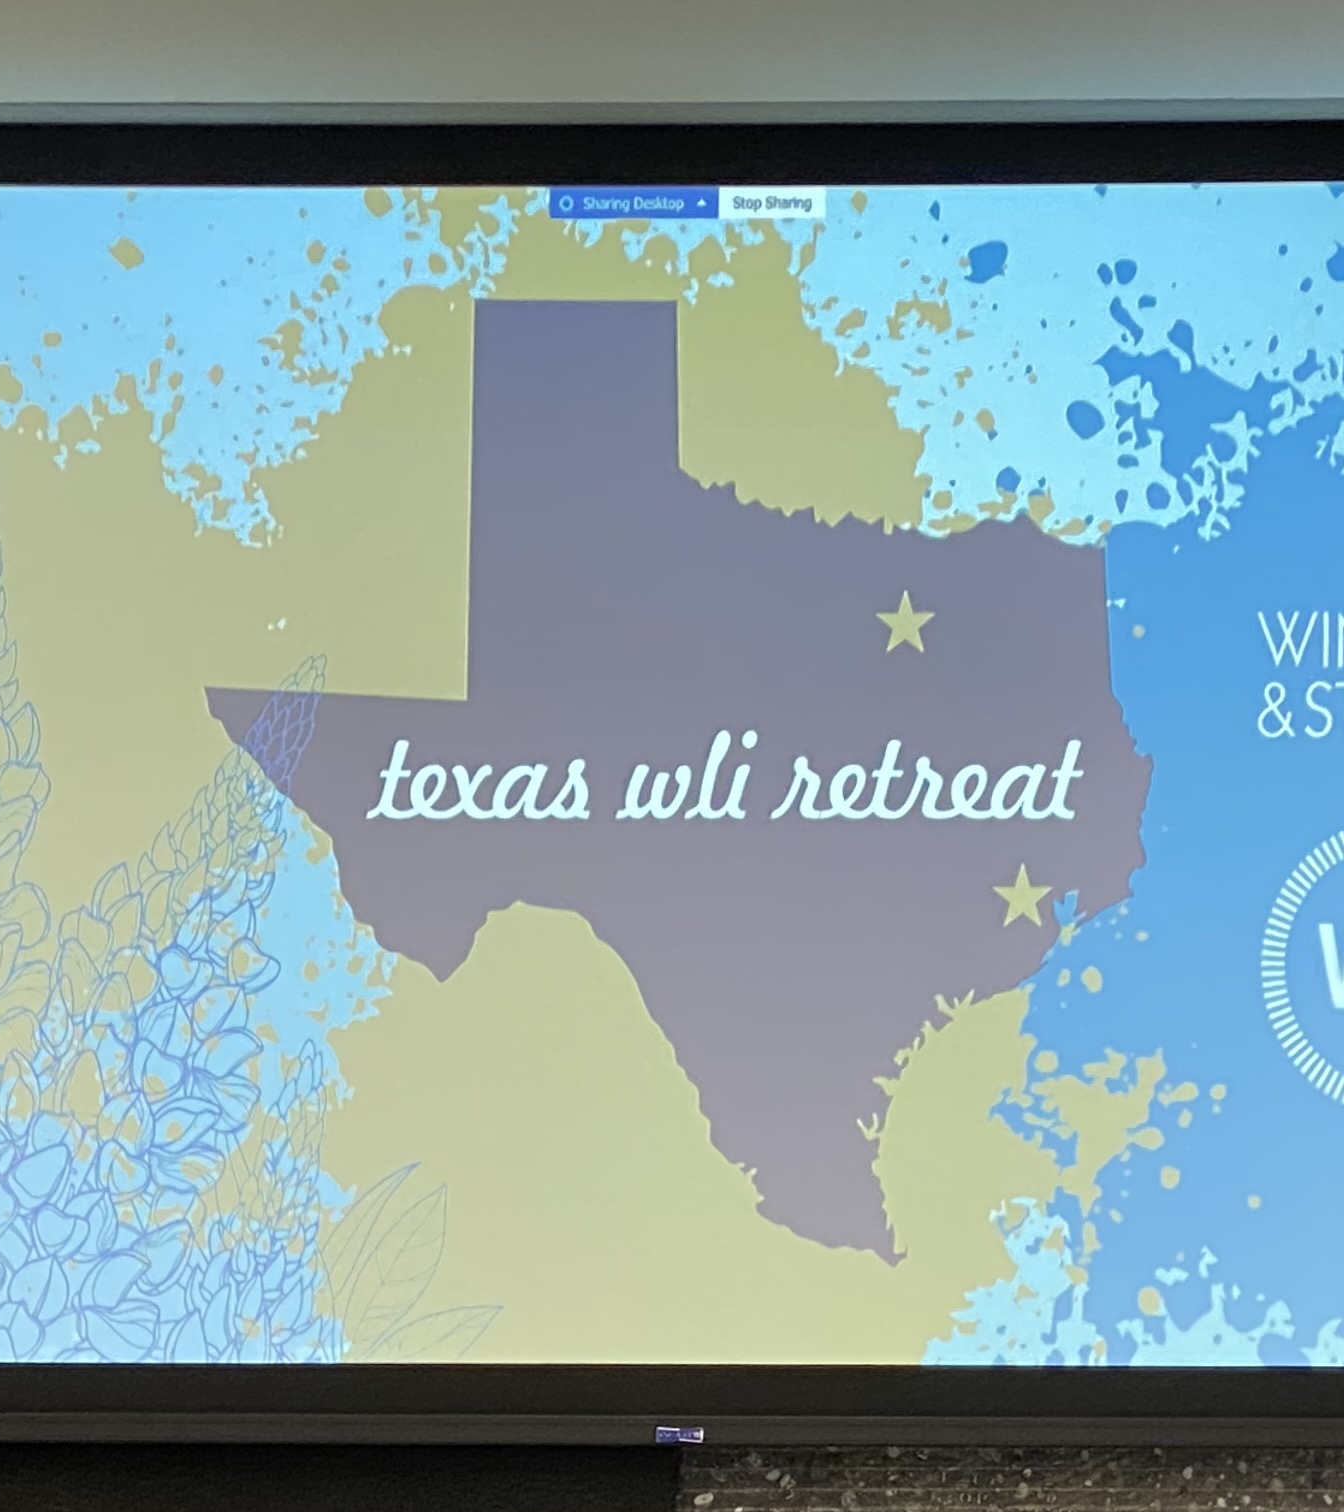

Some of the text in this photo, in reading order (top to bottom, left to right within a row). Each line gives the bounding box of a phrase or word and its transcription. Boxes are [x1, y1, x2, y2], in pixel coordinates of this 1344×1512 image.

[583, 197, 685, 212] Sharing Desktop
[733, 196, 813, 213] Stop Sharing
[1257, 681, 1297, 739] &
[366, 729, 1086, 821] texas wli retreat
